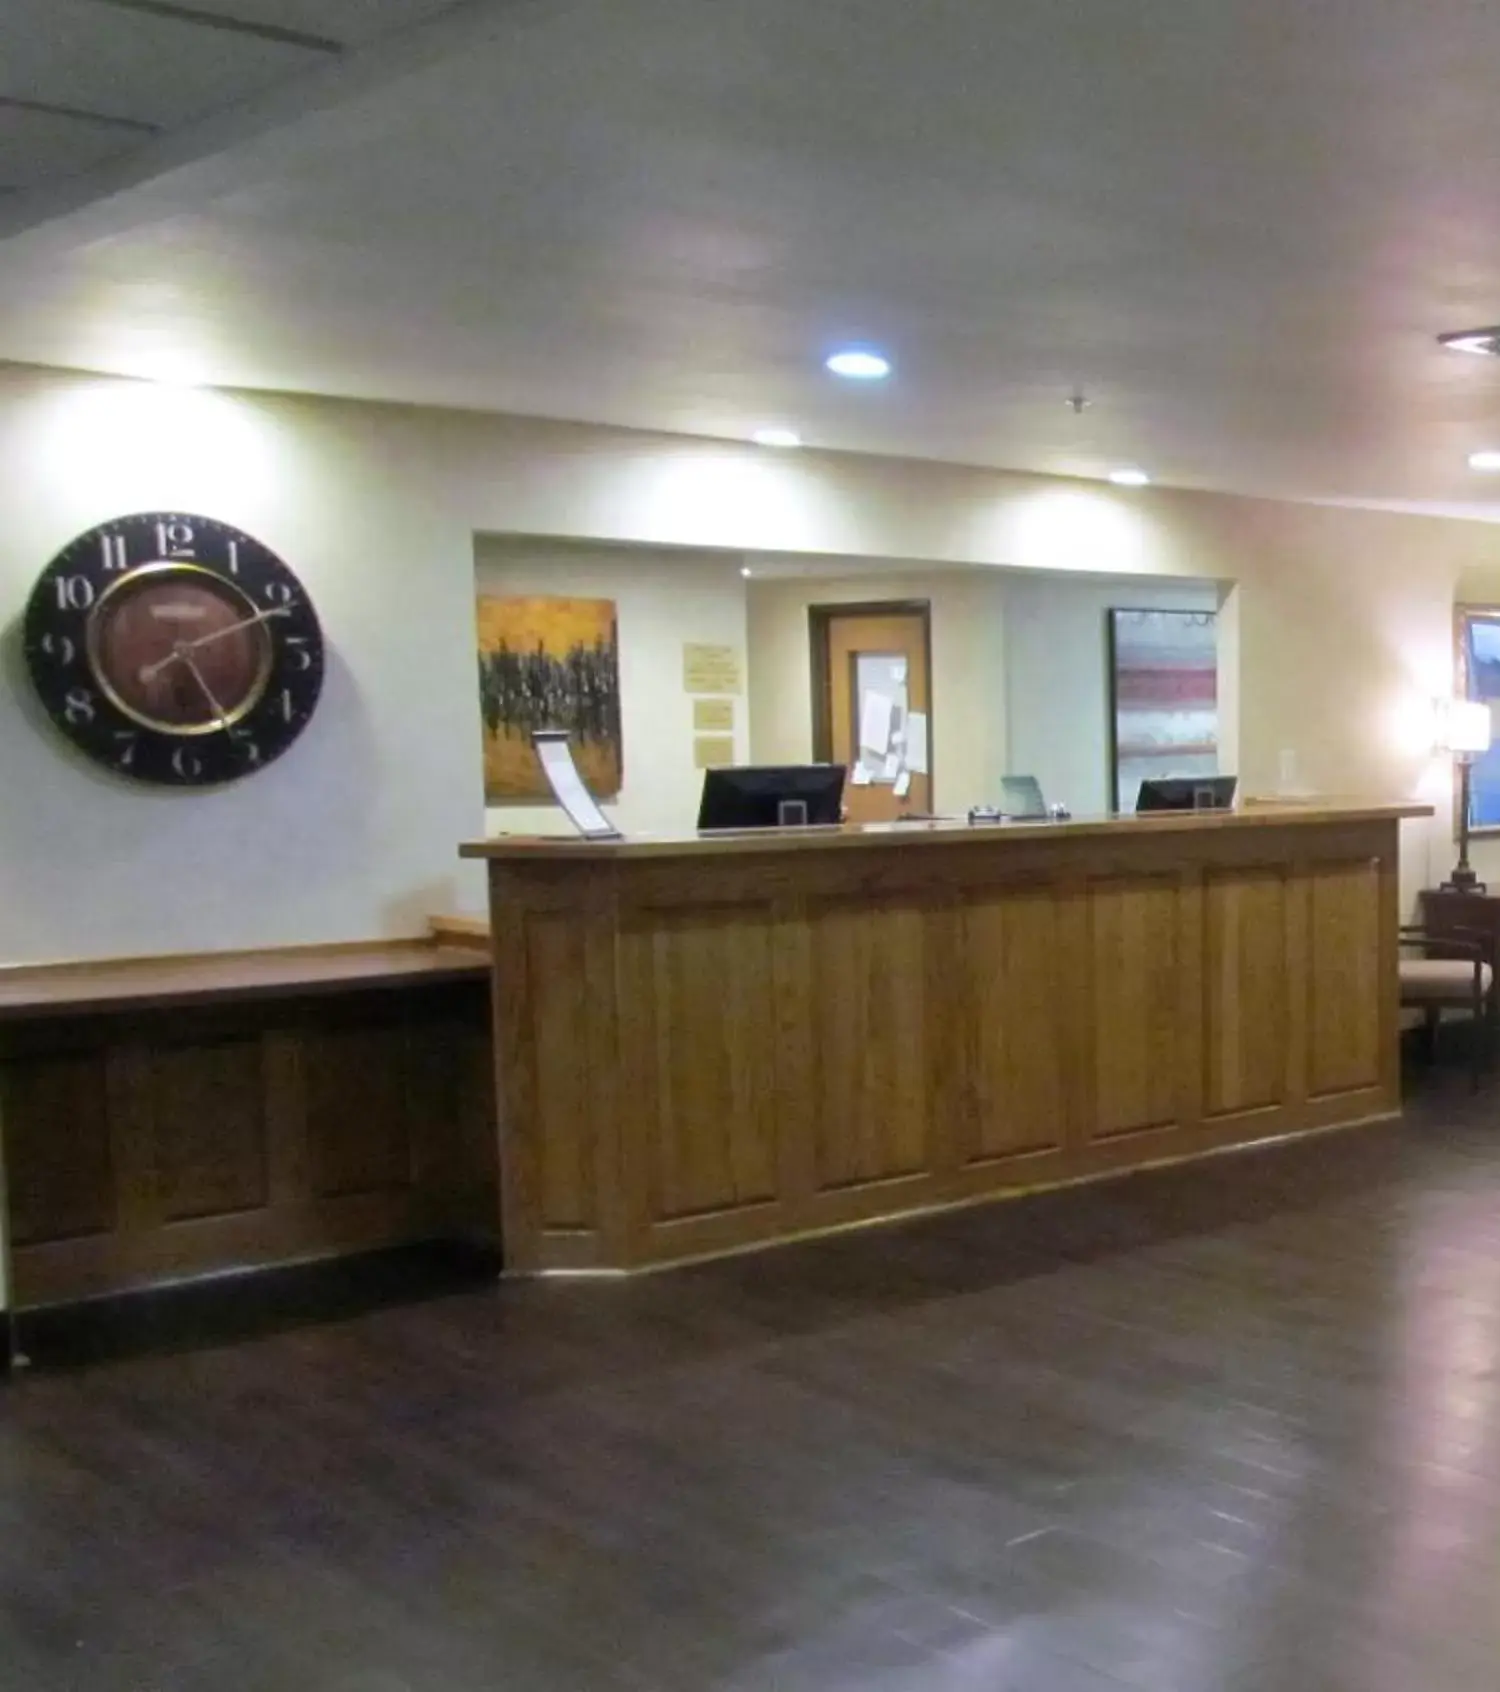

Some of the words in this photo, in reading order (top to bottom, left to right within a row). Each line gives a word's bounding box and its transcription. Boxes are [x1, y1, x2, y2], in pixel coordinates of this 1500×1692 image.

[101, 535, 127, 569] 11
[155, 521, 195, 557] 12
[228, 541, 239, 574] 1
[55, 575, 94, 610] 10
[265, 582, 293, 617] 2
[42, 633, 75, 666] 9
[285, 637, 311, 671] 3
[64, 687, 95, 725] 8
[113, 731, 136, 764] 7
[171, 747, 202, 778] 6
